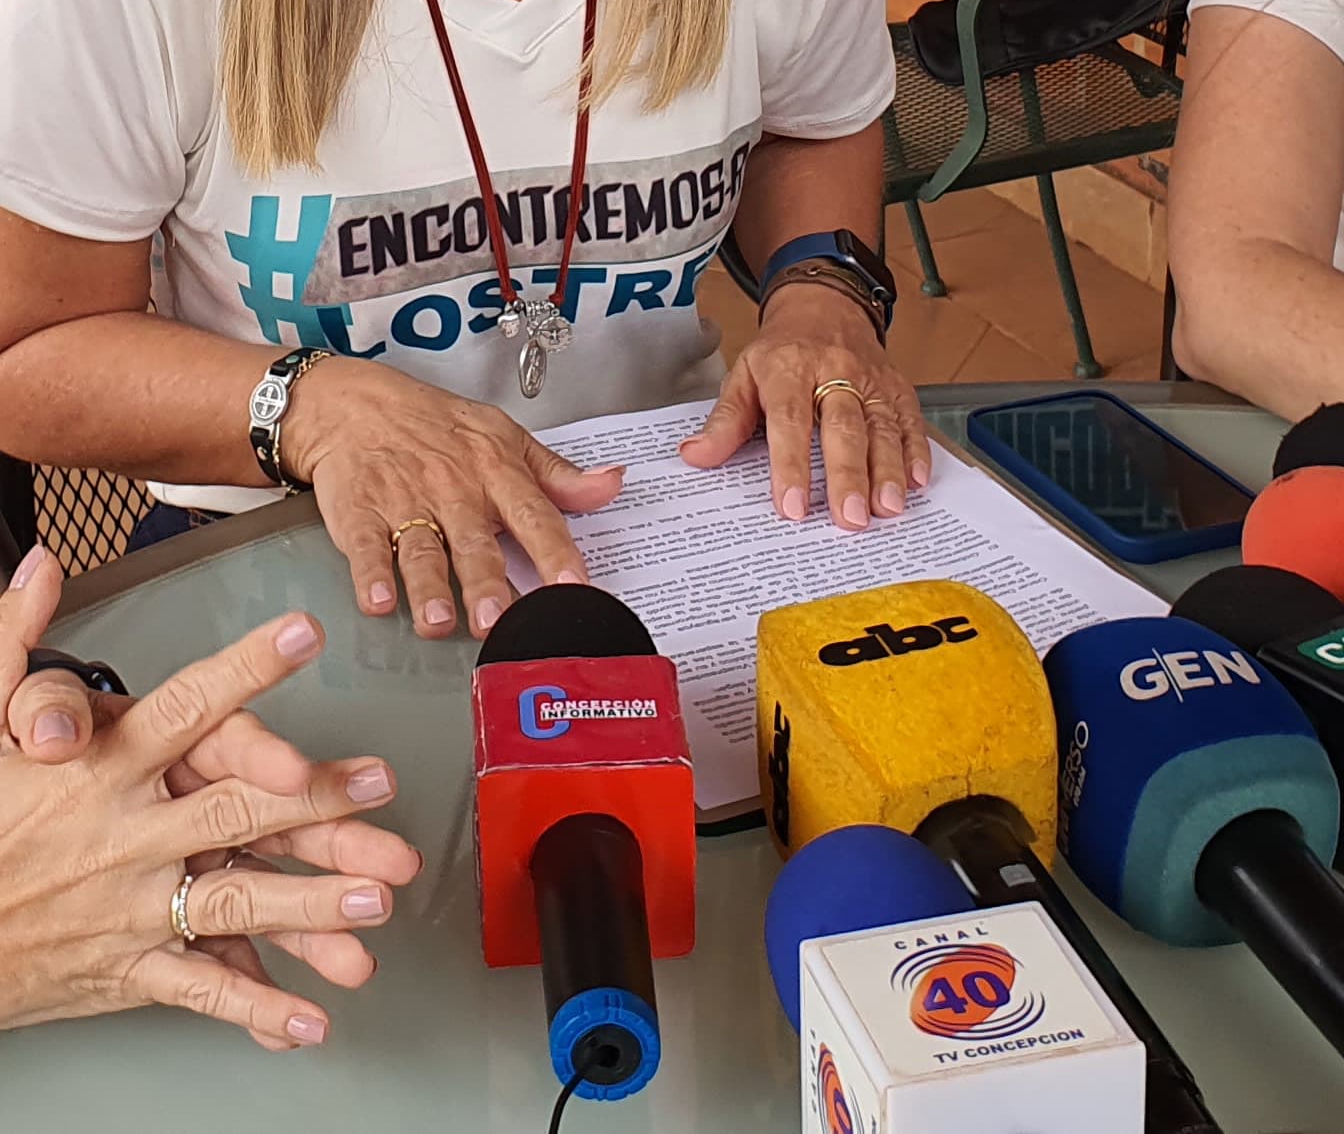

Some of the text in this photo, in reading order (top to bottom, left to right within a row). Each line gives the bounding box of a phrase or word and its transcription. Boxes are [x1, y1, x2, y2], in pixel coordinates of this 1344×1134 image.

[818, 615, 978, 666] abc
[542, 708, 656, 719] INFORMATIVO
[894, 925, 989, 951] CANAL
[922, 969, 1011, 1016] 40
[933, 1028, 1085, 1065] TV CONCEPCION
